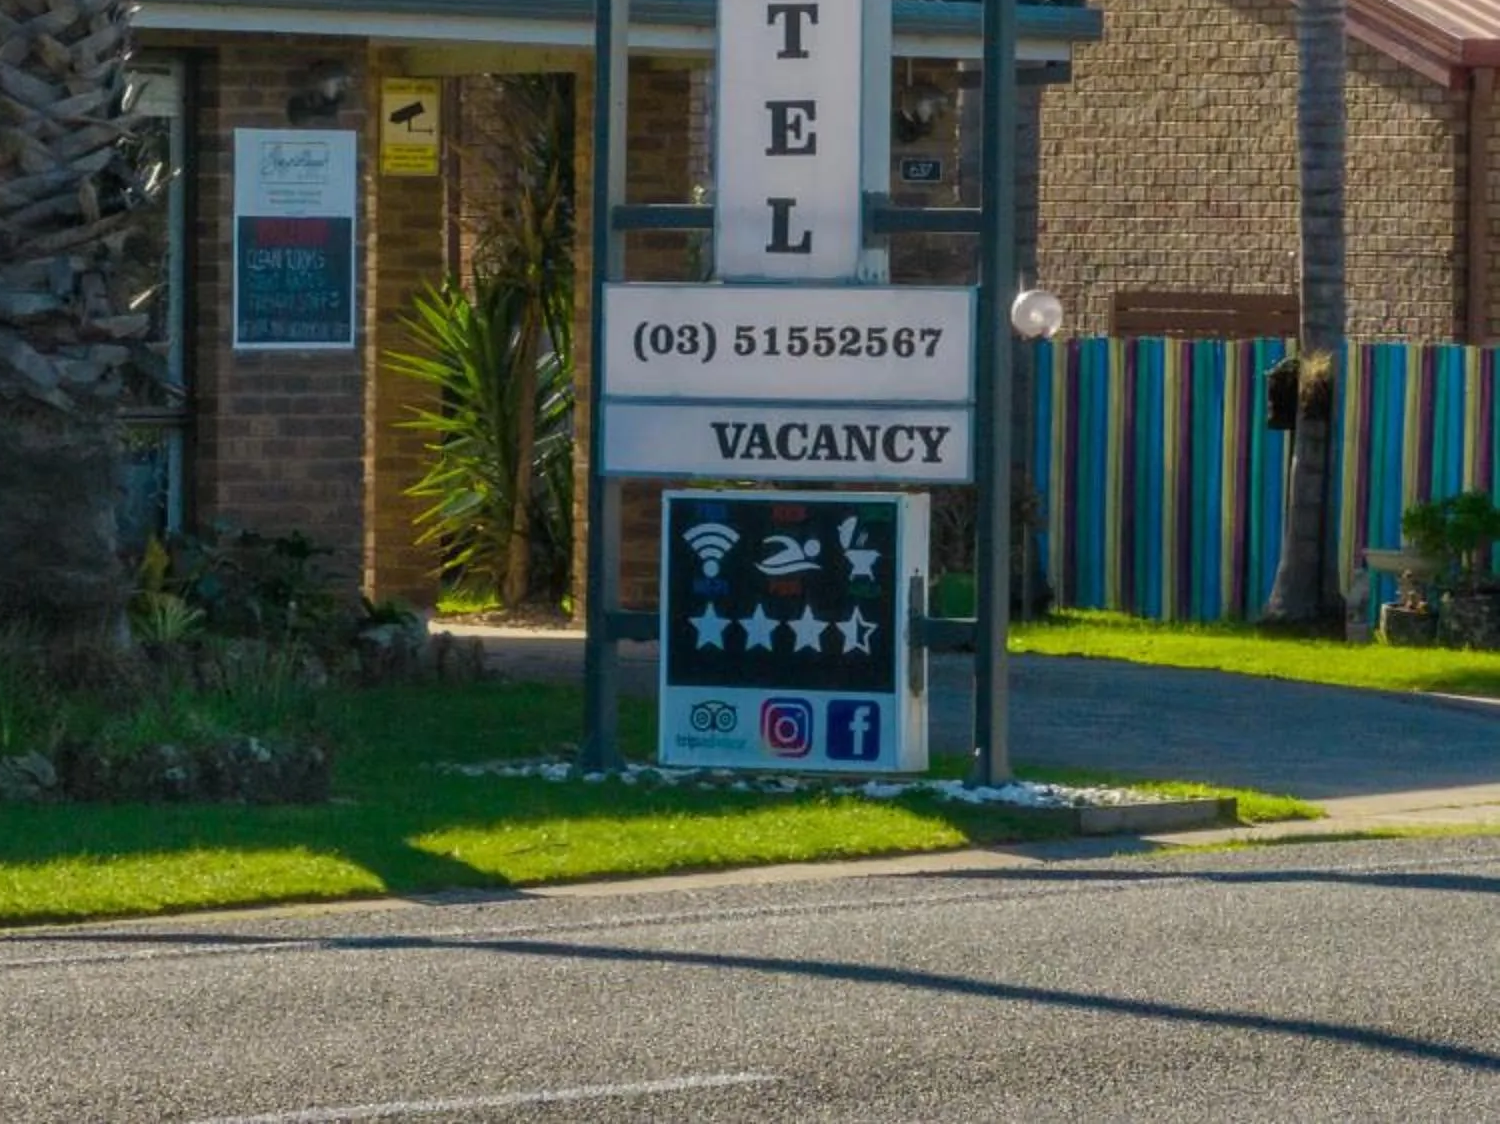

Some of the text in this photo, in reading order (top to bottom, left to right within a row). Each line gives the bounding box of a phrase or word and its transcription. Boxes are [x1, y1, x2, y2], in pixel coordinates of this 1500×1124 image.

[633, 321, 943, 363] (03) 51552567
[711, 421, 951, 464] VACANCY
